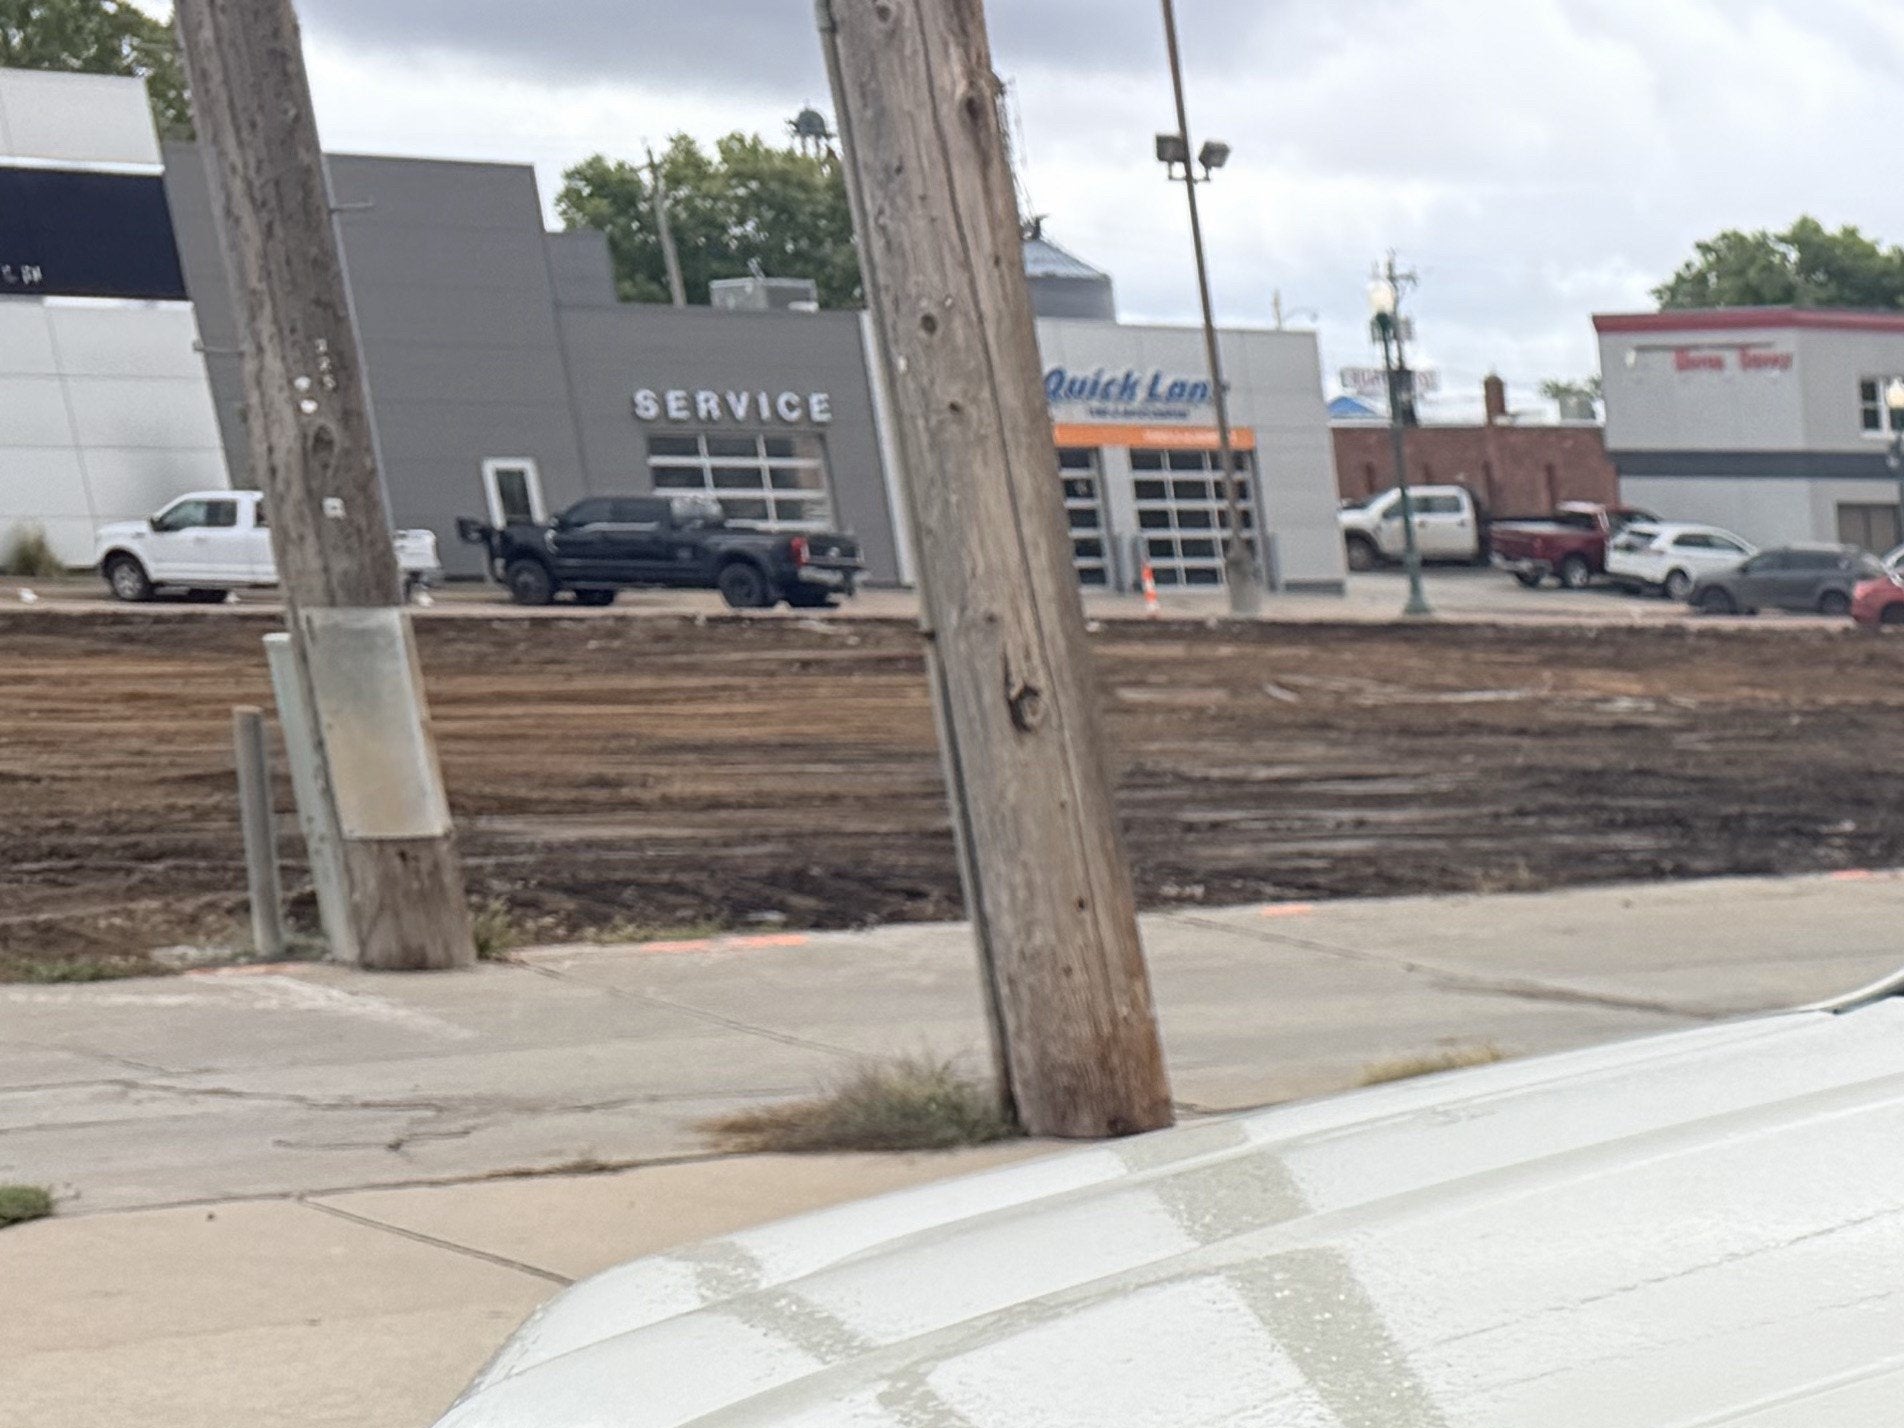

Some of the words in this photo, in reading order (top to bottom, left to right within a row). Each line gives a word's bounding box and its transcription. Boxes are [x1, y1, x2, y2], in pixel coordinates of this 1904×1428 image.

[1045, 368, 1139, 402] Quick
[1147, 369, 1217, 402] Lan
[633, 388, 833, 423] SERVICE
